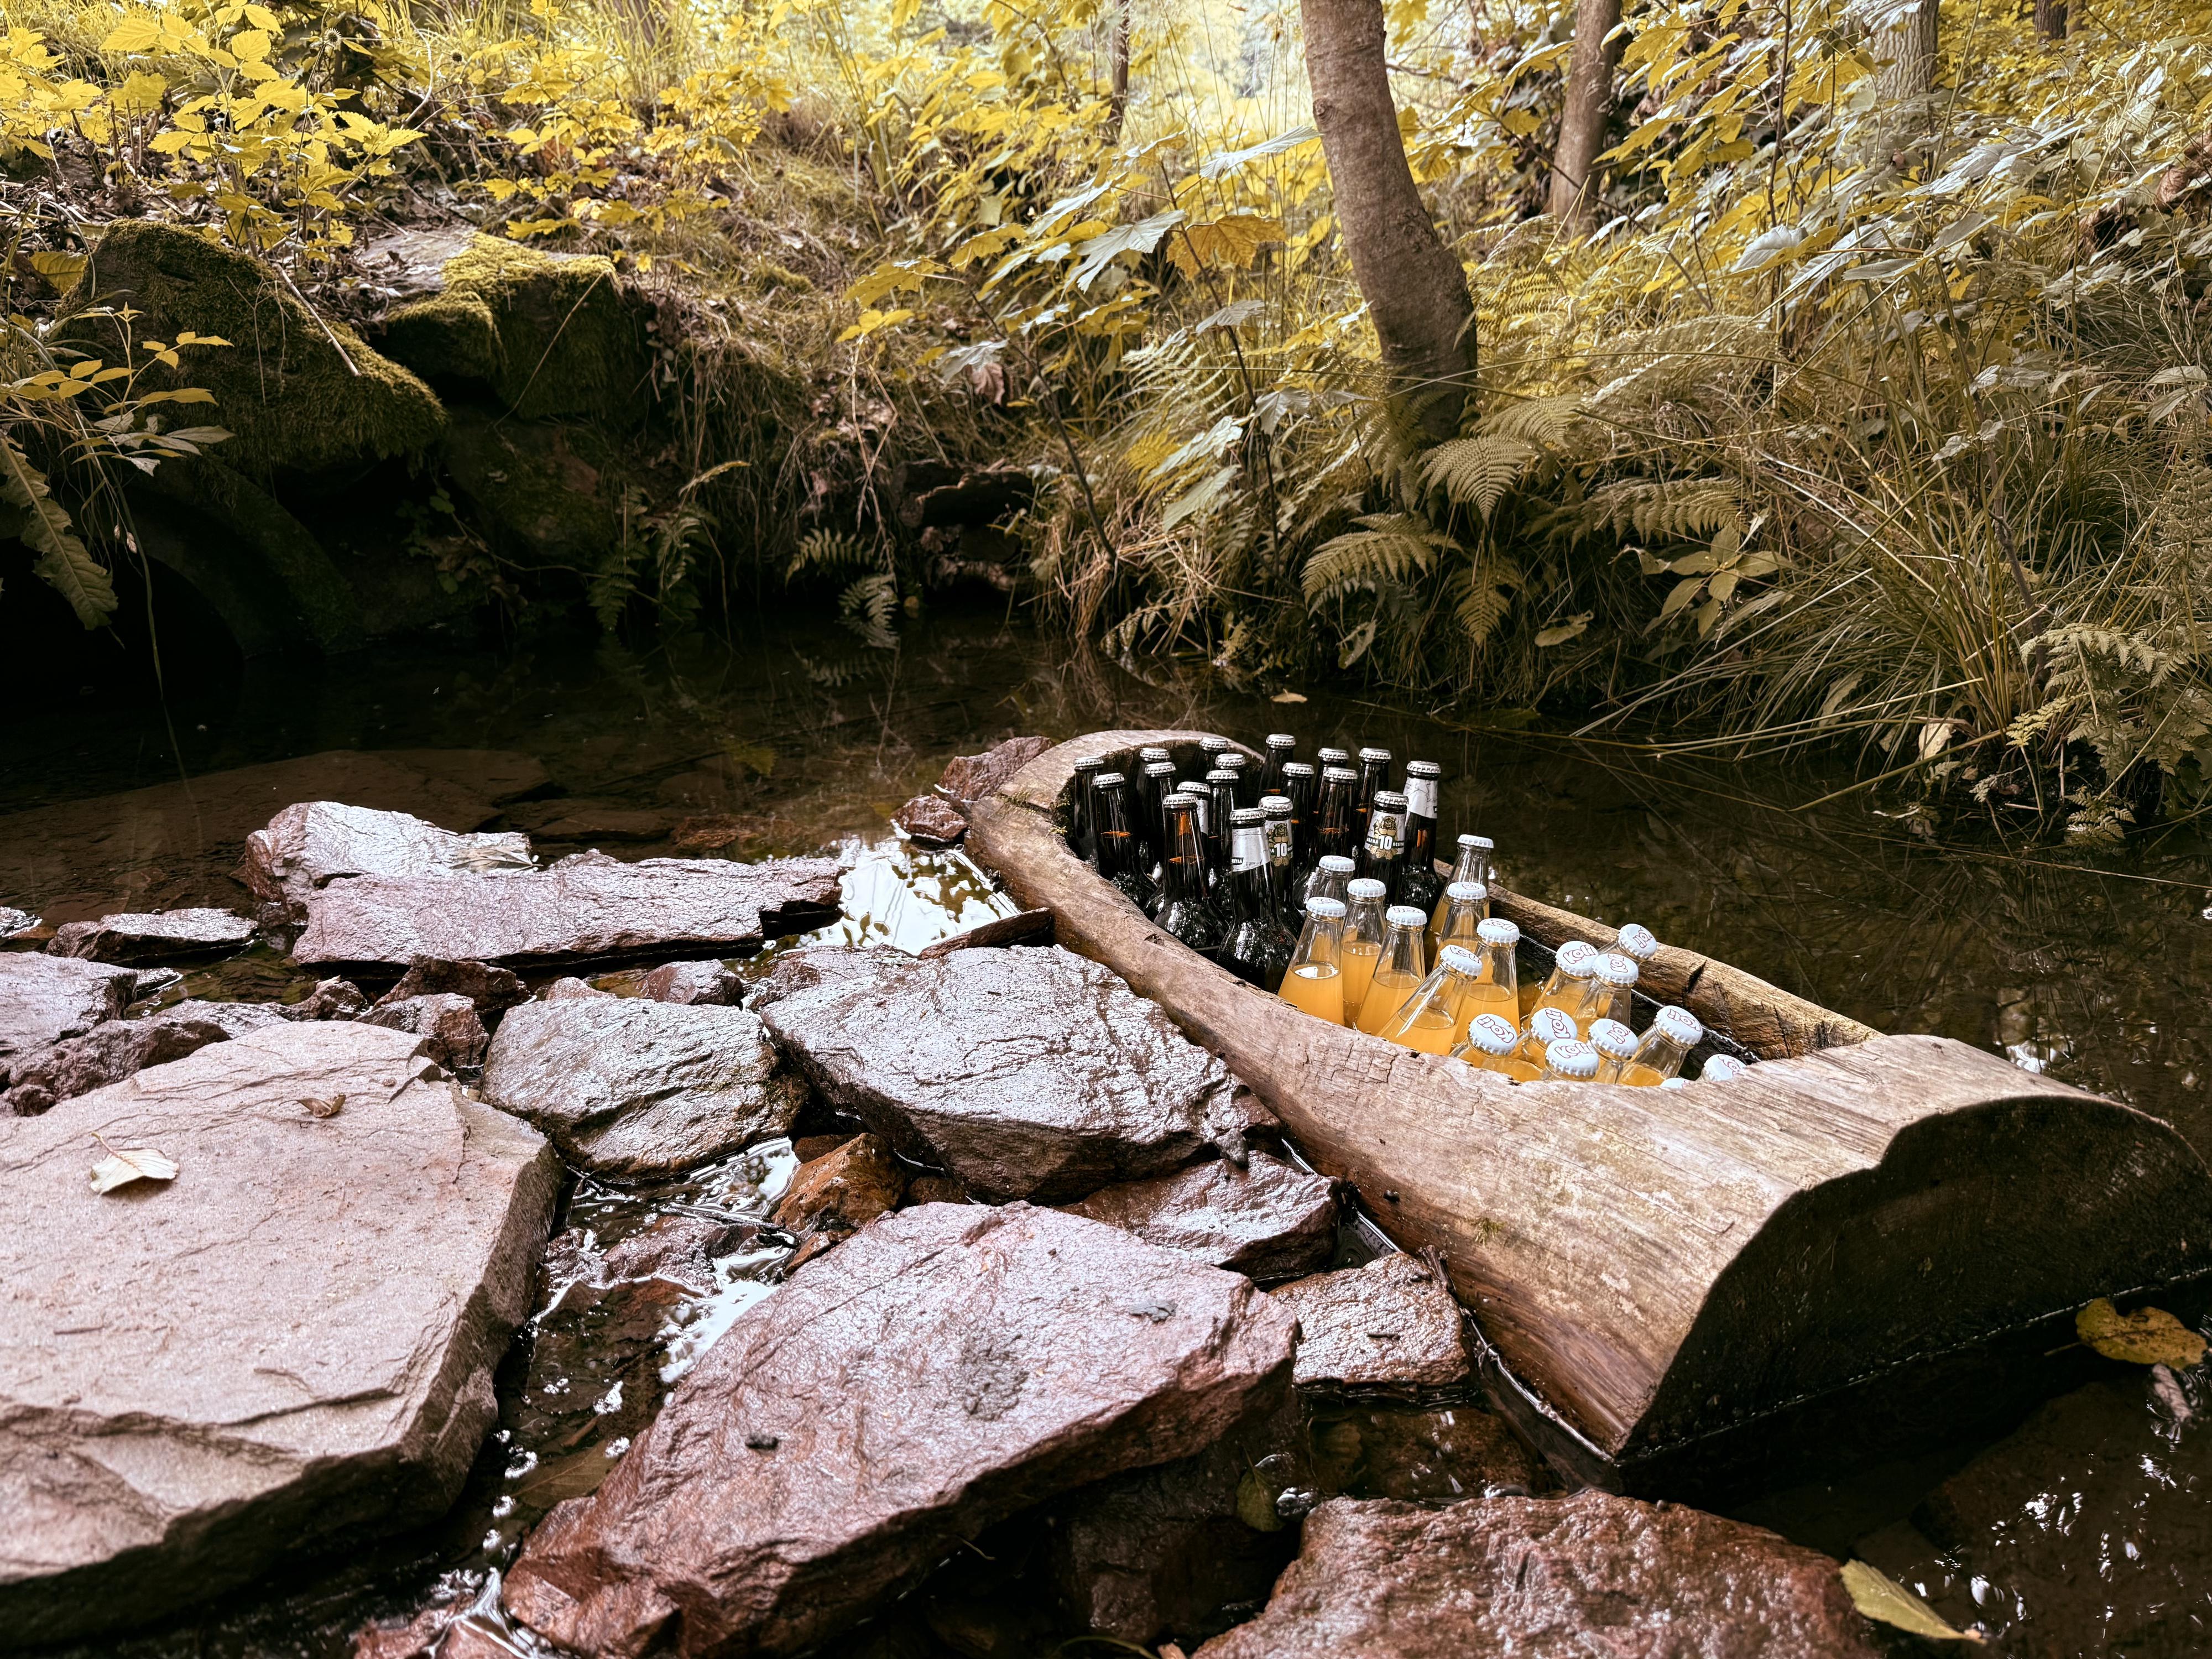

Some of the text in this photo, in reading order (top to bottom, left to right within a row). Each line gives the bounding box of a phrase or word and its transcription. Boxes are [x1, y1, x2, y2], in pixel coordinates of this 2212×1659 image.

[1274, 843, 1287, 857] 10
[1379, 835, 1392, 850] 10
[1563, 945, 1596, 964] Koli
[1477, 1016, 1515, 1044] Koli
[1545, 1009, 1571, 1039] Koli
[1554, 1042, 1594, 1059] Koli
